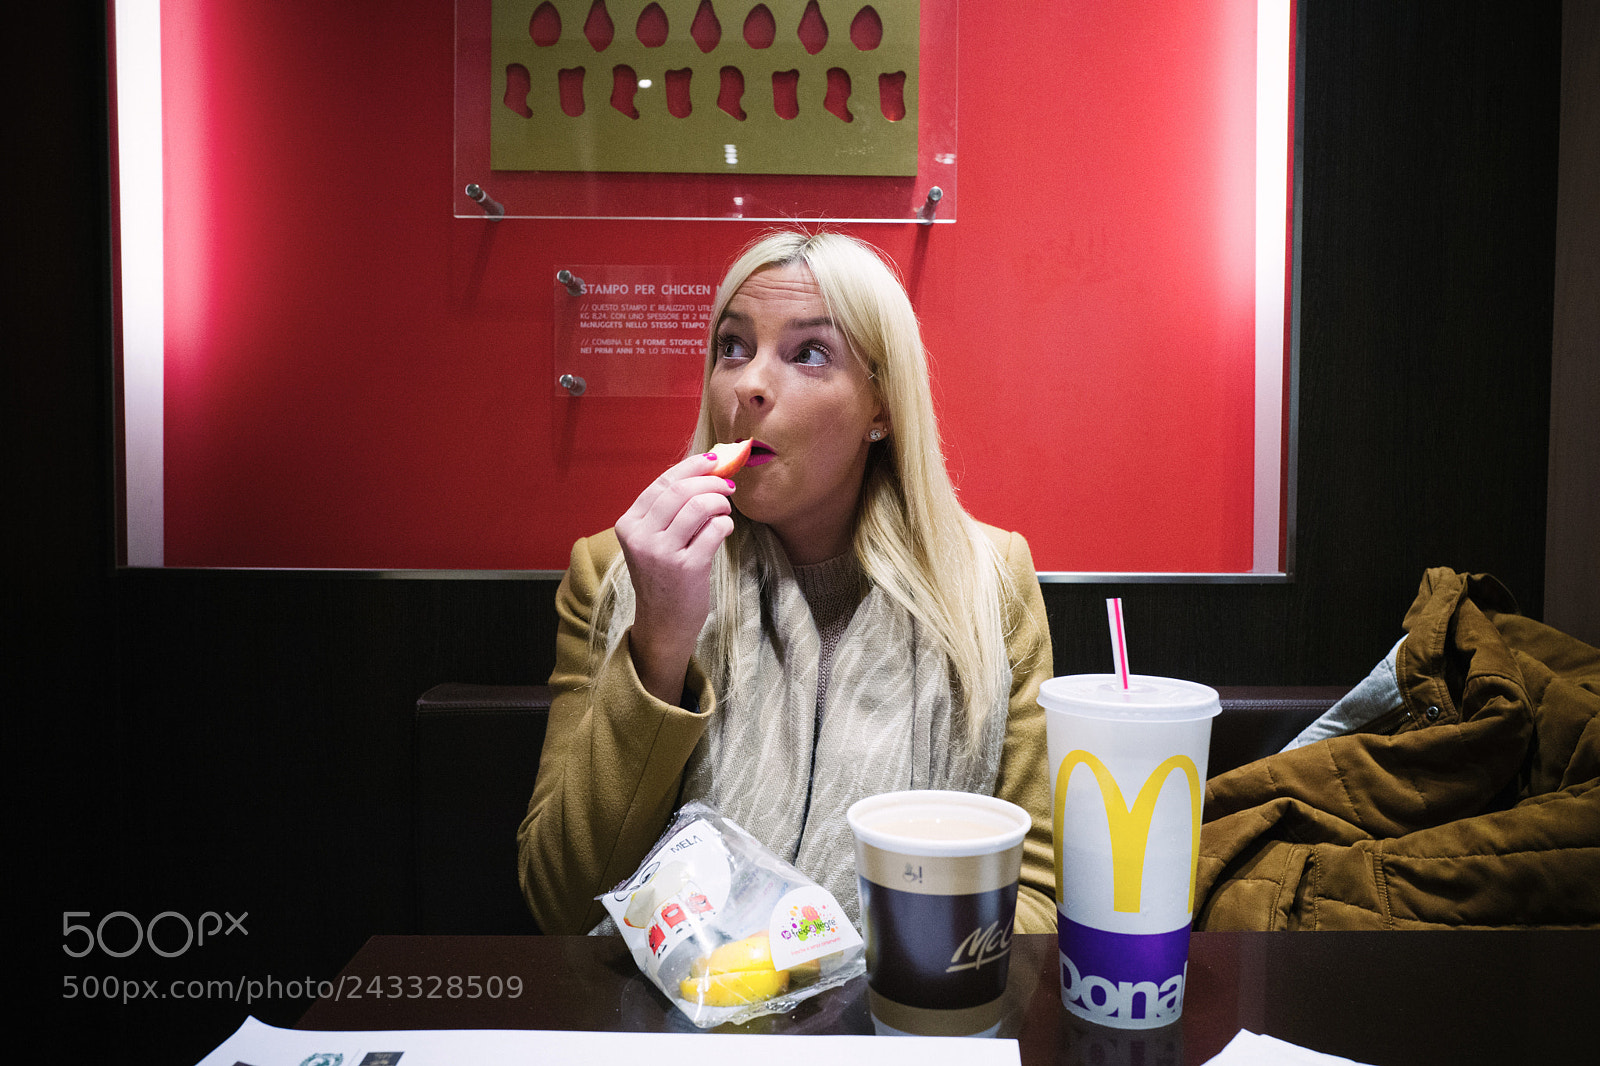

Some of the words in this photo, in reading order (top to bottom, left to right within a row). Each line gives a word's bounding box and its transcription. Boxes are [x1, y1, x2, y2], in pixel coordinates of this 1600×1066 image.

[580, 284, 629, 295] STAMPO
[634, 284, 655, 295] PER
[661, 284, 711, 295] CHICKEN
[591, 304, 618, 312] QUESTO
[621, 304, 647, 312] STAMPO
[658, 304, 695, 312] REALIZZATO
[580, 312, 590, 320] KG
[611, 312, 626, 320] CON
[628, 312, 644, 320] UNO
[647, 312, 679, 320] SPESSORE
[682, 312, 690, 320] DI
[692, 312, 697, 320] 2
[580, 321, 623, 329] McNUGGETS
[625, 321, 648, 329] NELLO
[651, 321, 678, 329] STESSO
[591, 338, 622, 346] COMBINA
[624, 338, 632, 346] LE
[635, 338, 640, 346] 4
[643, 338, 666, 346] FORME
[669, 338, 703, 346] STORICHE
[580, 347, 592, 355] NEI
[594, 347, 613, 355] PRIMI
[616, 347, 633, 355] ANNI
[648, 347, 658, 355] LO
[670, 835, 703, 853] MELA
